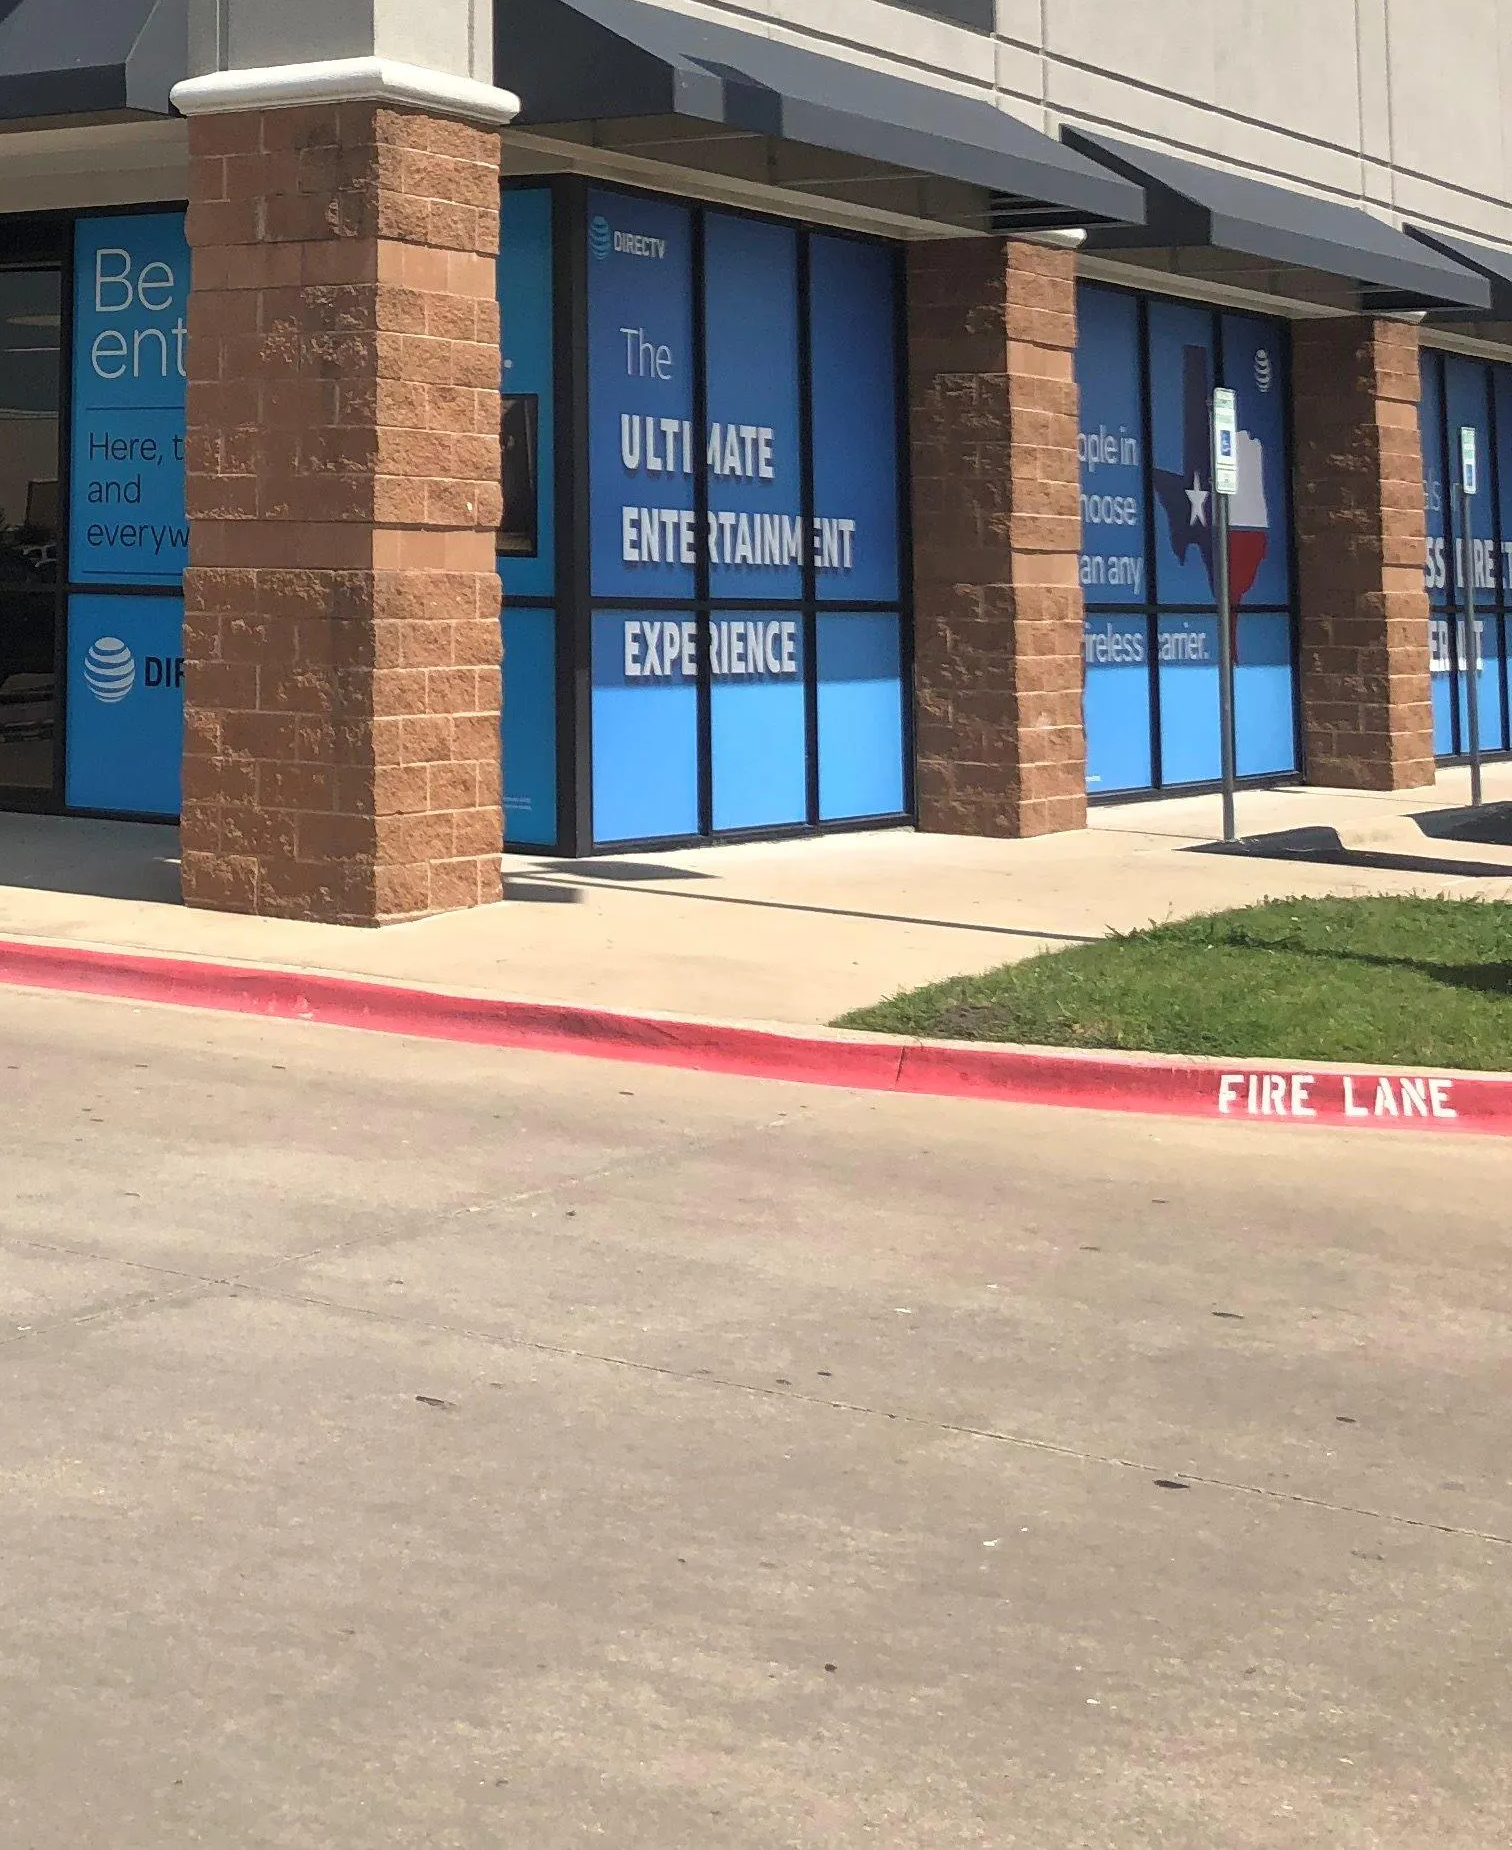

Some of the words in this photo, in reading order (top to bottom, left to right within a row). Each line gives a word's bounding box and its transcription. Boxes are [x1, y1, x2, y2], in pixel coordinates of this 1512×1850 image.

[613, 230, 665, 259] DIRECTV
[96, 248, 174, 312] Be
[90, 317, 187, 379] ent
[619, 327, 672, 380] The
[89, 432, 163, 465] Here,
[621, 413, 775, 478] ULTIMATE
[1120, 425, 1138, 466] in
[88, 474, 141, 504] and
[87, 523, 190, 555] everyw
[1107, 556, 1144, 595] any
[1084, 622, 1144, 663] ireless
[1218, 1074, 1317, 1117] FIRE
[1342, 1075, 1458, 1118] LANE
